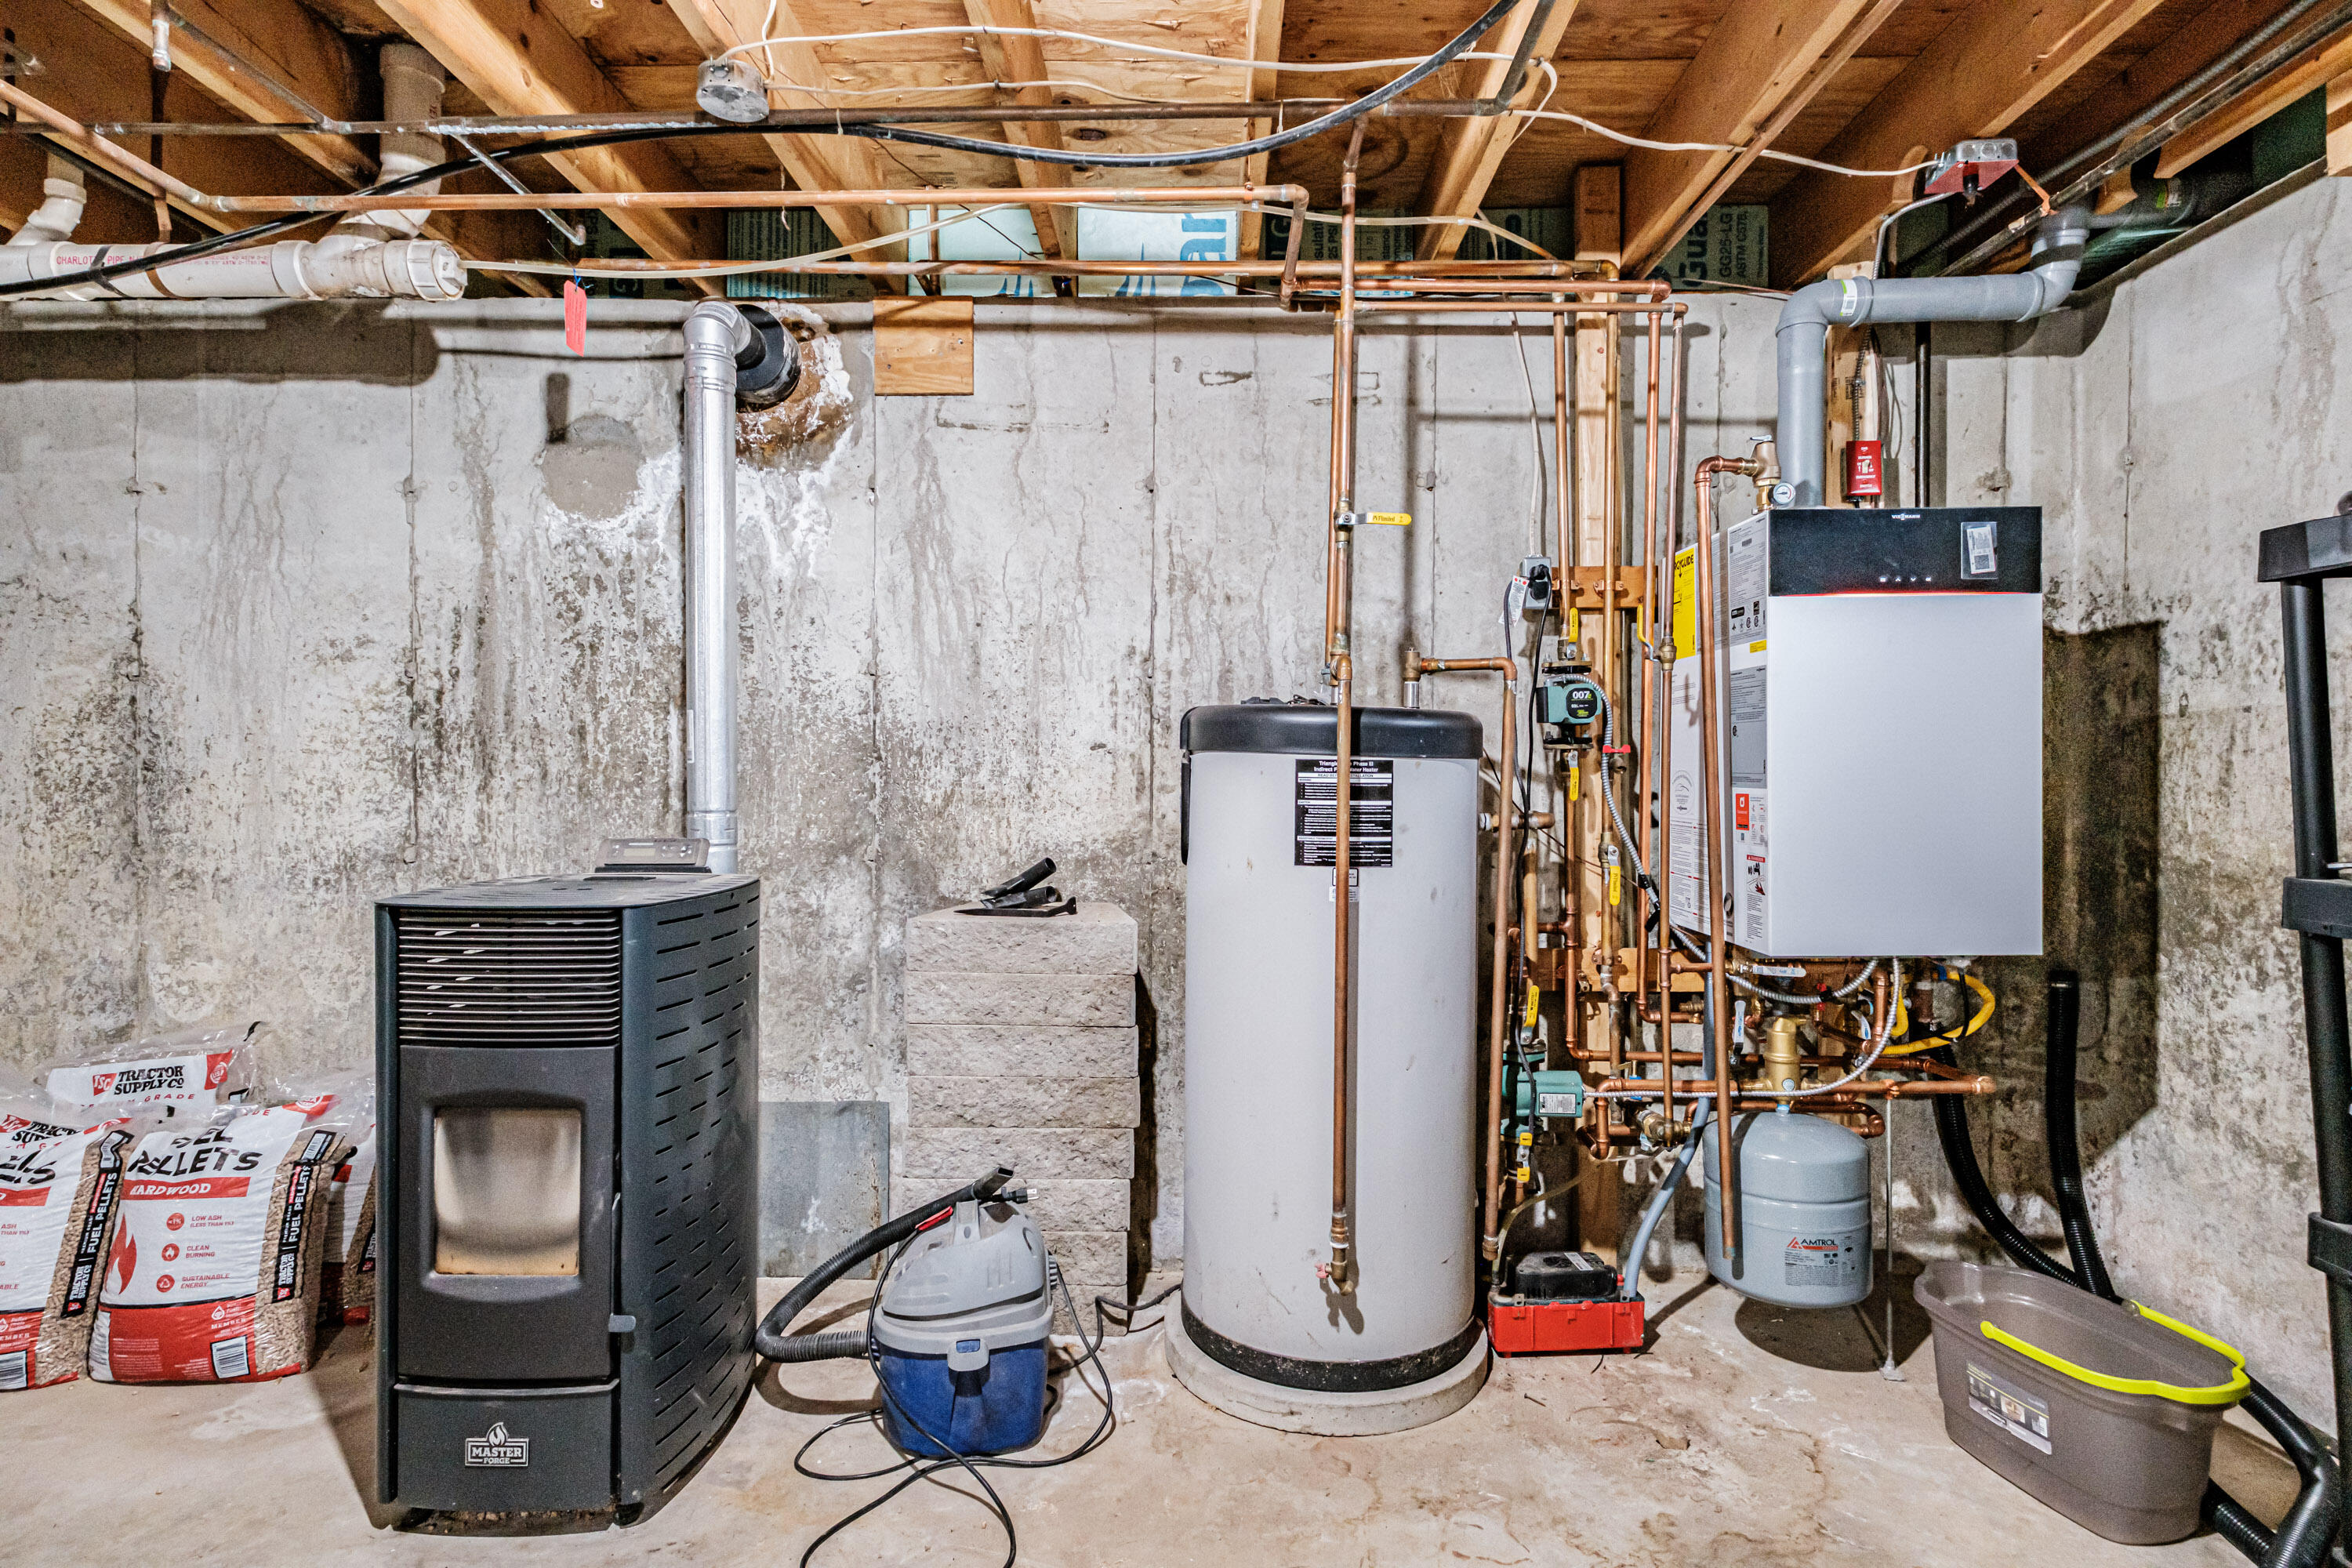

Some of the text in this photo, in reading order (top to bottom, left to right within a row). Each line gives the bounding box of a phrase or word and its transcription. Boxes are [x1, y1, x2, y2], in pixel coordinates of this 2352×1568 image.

[56, 256, 95, 265] CHARLOT
[1736, 245, 1747, 278] ASTM
[118, 1065, 184, 1083] TRACTOR
[114, 1080, 167, 1095] SUPPLY
[143, 1093, 195, 1103] GRADE
[289, 1165, 311, 1242] FUEL PELLETS
[87, 1171, 118, 1254] FUEL PELLETS
[181, 1273, 230, 1283] SUSTAINABLE
[471, 1446, 522, 1457] MASTER
